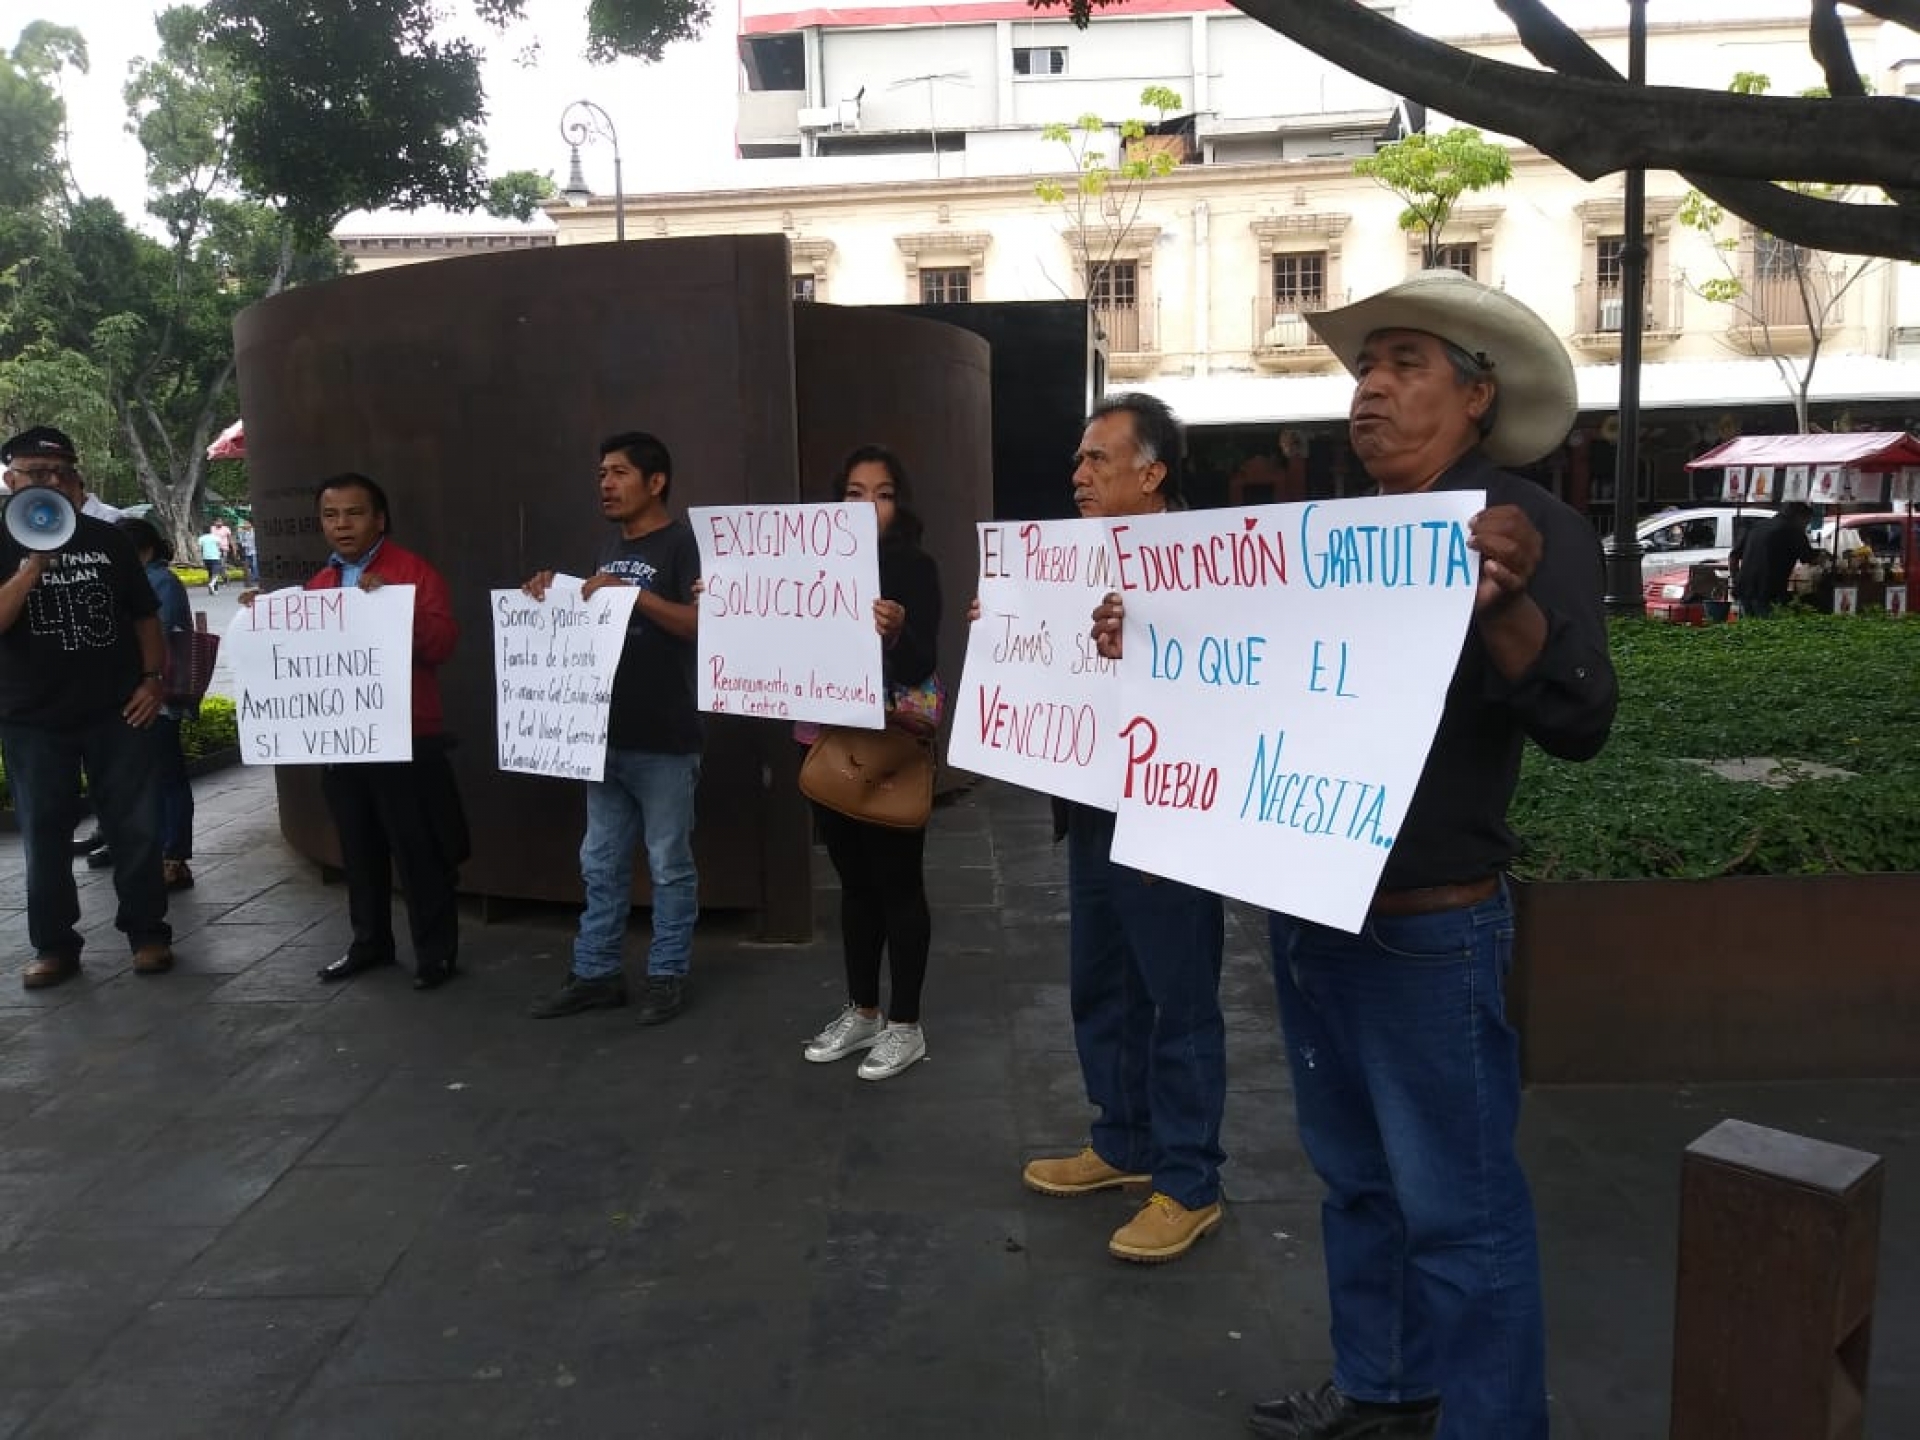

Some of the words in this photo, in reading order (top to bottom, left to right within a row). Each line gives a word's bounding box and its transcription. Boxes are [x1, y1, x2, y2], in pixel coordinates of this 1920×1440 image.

[710, 509, 857, 556] EXIGIMOS
[983, 527, 1011, 578] EL
[1019, 523, 1079, 582] PUEBLO
[1111, 517, 1288, 592] EDUCACIÓN
[1301, 503, 1471, 589] GRATUITA
[28, 582, 117, 651] 43
[498, 595, 545, 630] Somos
[709, 569, 859, 620] SOLUCIÓN
[272, 643, 381, 680] ENTIENDE
[993, 614, 1054, 667] JAMÁS
[1148, 623, 1184, 681] LO
[1199, 636, 1267, 686] QUE
[1308, 640, 1359, 698] EL
[241, 688, 344, 721] AMILCINGO
[355, 682, 384, 712] NO
[980, 684, 1096, 767] VENCIDO
[302, 723, 380, 756] VENDE
[1118, 715, 1218, 811] PUEBLO
